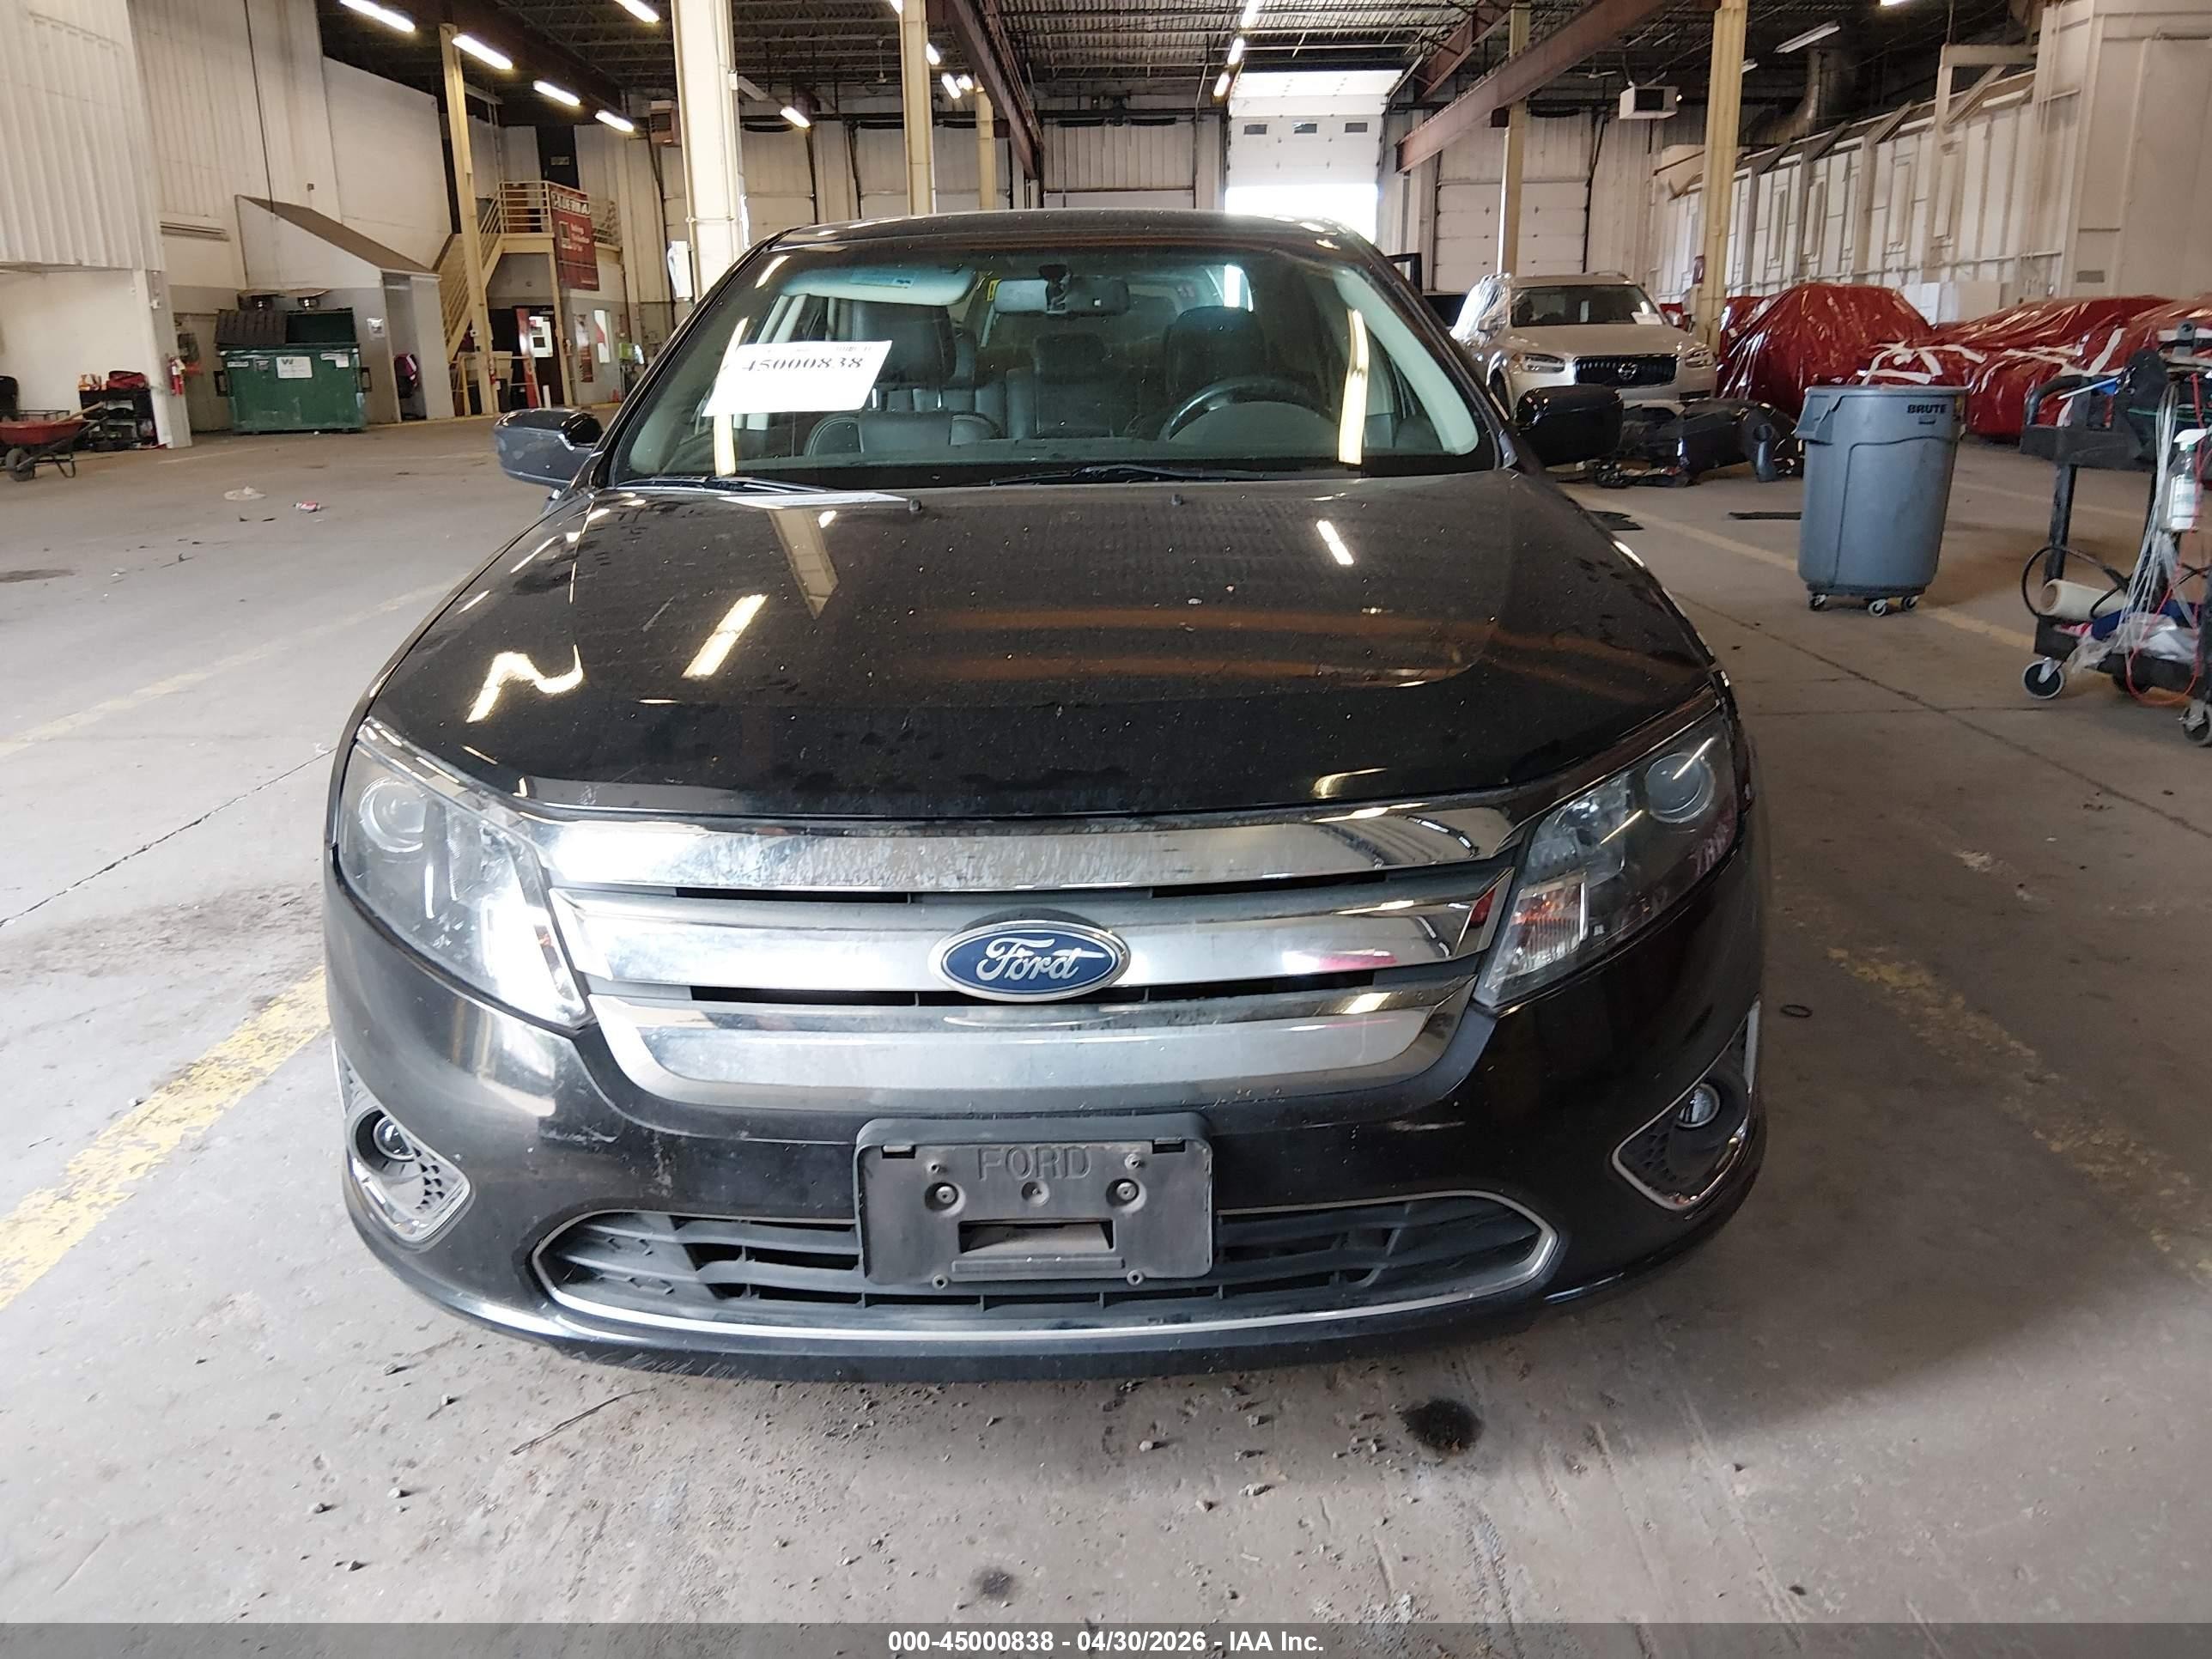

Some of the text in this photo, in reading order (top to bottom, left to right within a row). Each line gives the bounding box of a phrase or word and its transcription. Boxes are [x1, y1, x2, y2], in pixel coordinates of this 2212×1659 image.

[742, 356, 865, 372] 45000838
[1906, 404, 1948, 414] BRUTE
[975, 936, 1106, 981] Ford
[977, 1146, 1092, 1181] FORD
